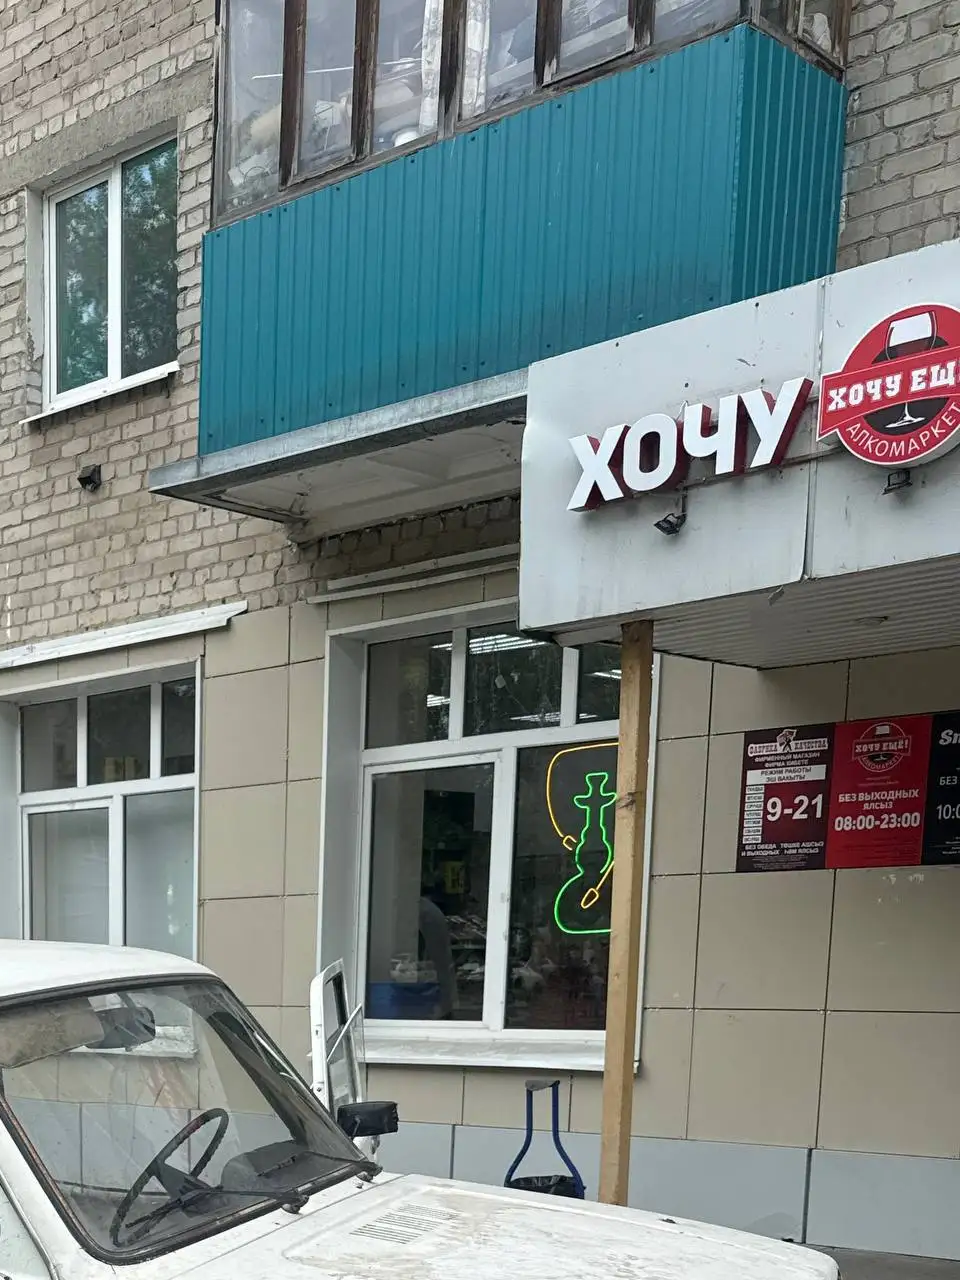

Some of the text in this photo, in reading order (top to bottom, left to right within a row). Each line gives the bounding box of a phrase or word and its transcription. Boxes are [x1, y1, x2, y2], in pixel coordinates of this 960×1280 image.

[828, 360, 960, 412] ХОЧУ ЕЩ
[846, 402, 960, 457] АЛКОМАРКЕТ
[567, 377, 812, 511] ХОЧУ
[939, 776, 958, 786] БЕЗ
[766, 793, 823, 821] 9-21
[838, 789, 920, 802] БЕЗ ВЫХОДНЫХ
[863, 801, 894, 810] ЯЛСЫЗ
[834, 812, 921, 831] 08:00-23:00
